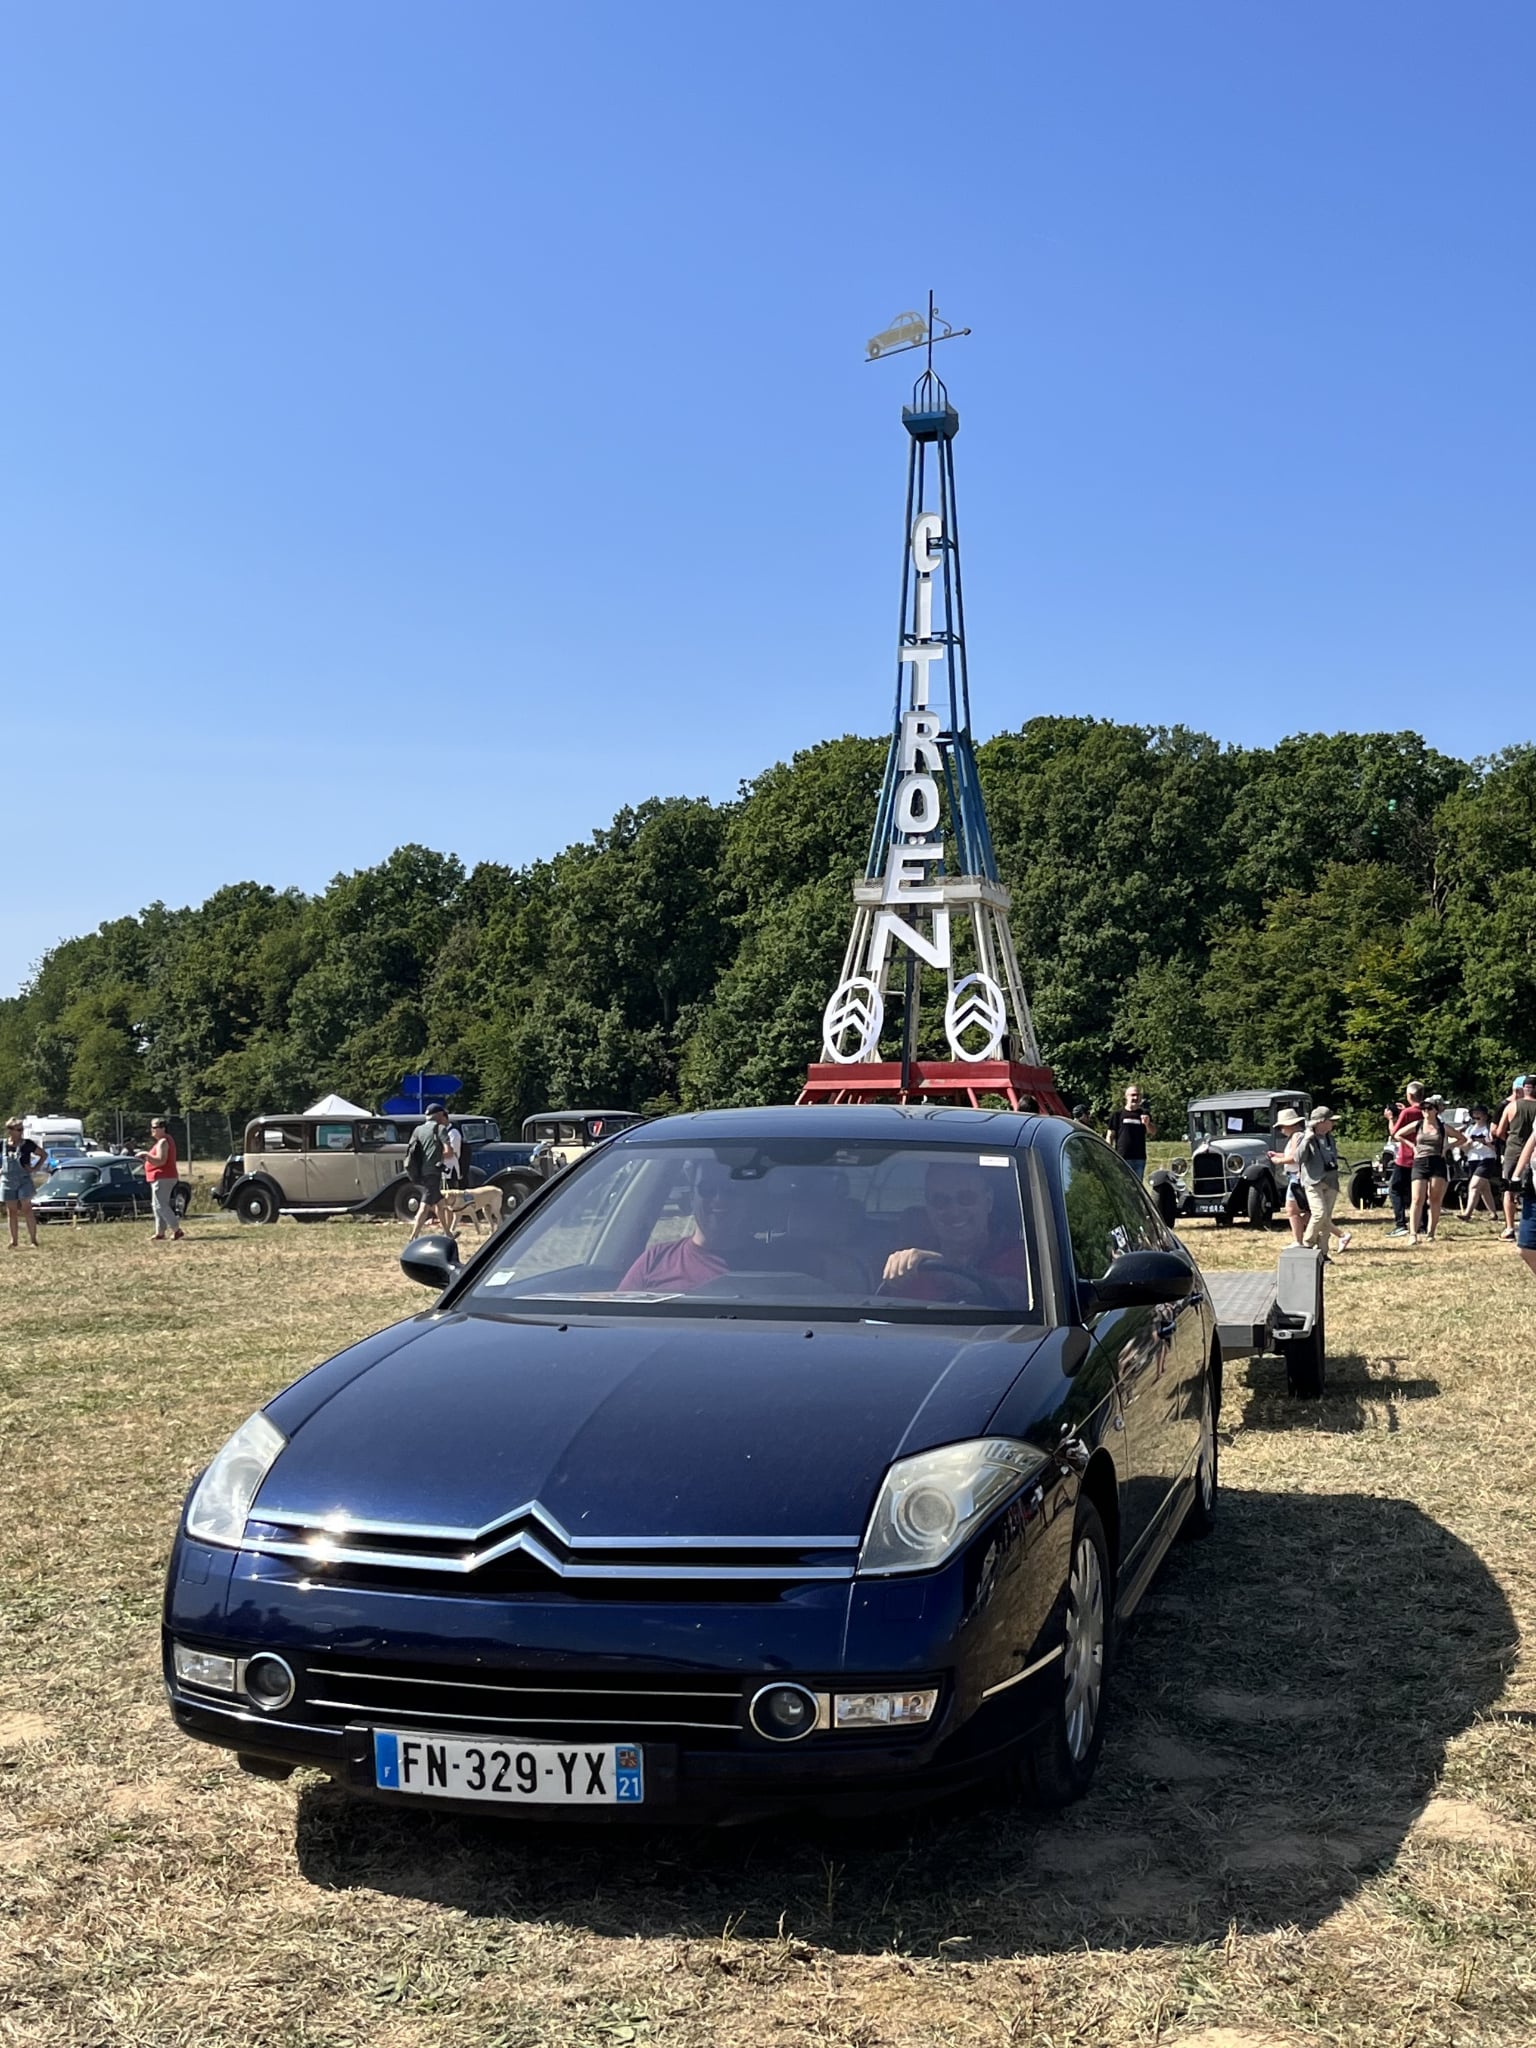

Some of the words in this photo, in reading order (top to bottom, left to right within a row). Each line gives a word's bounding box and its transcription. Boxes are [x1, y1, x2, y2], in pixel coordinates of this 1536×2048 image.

[868, 511, 950, 970] CITROËN
[383, 1765, 391, 1778] F
[402, 1741, 607, 1795] FN-329-YX
[618, 1776, 640, 1797] 21
